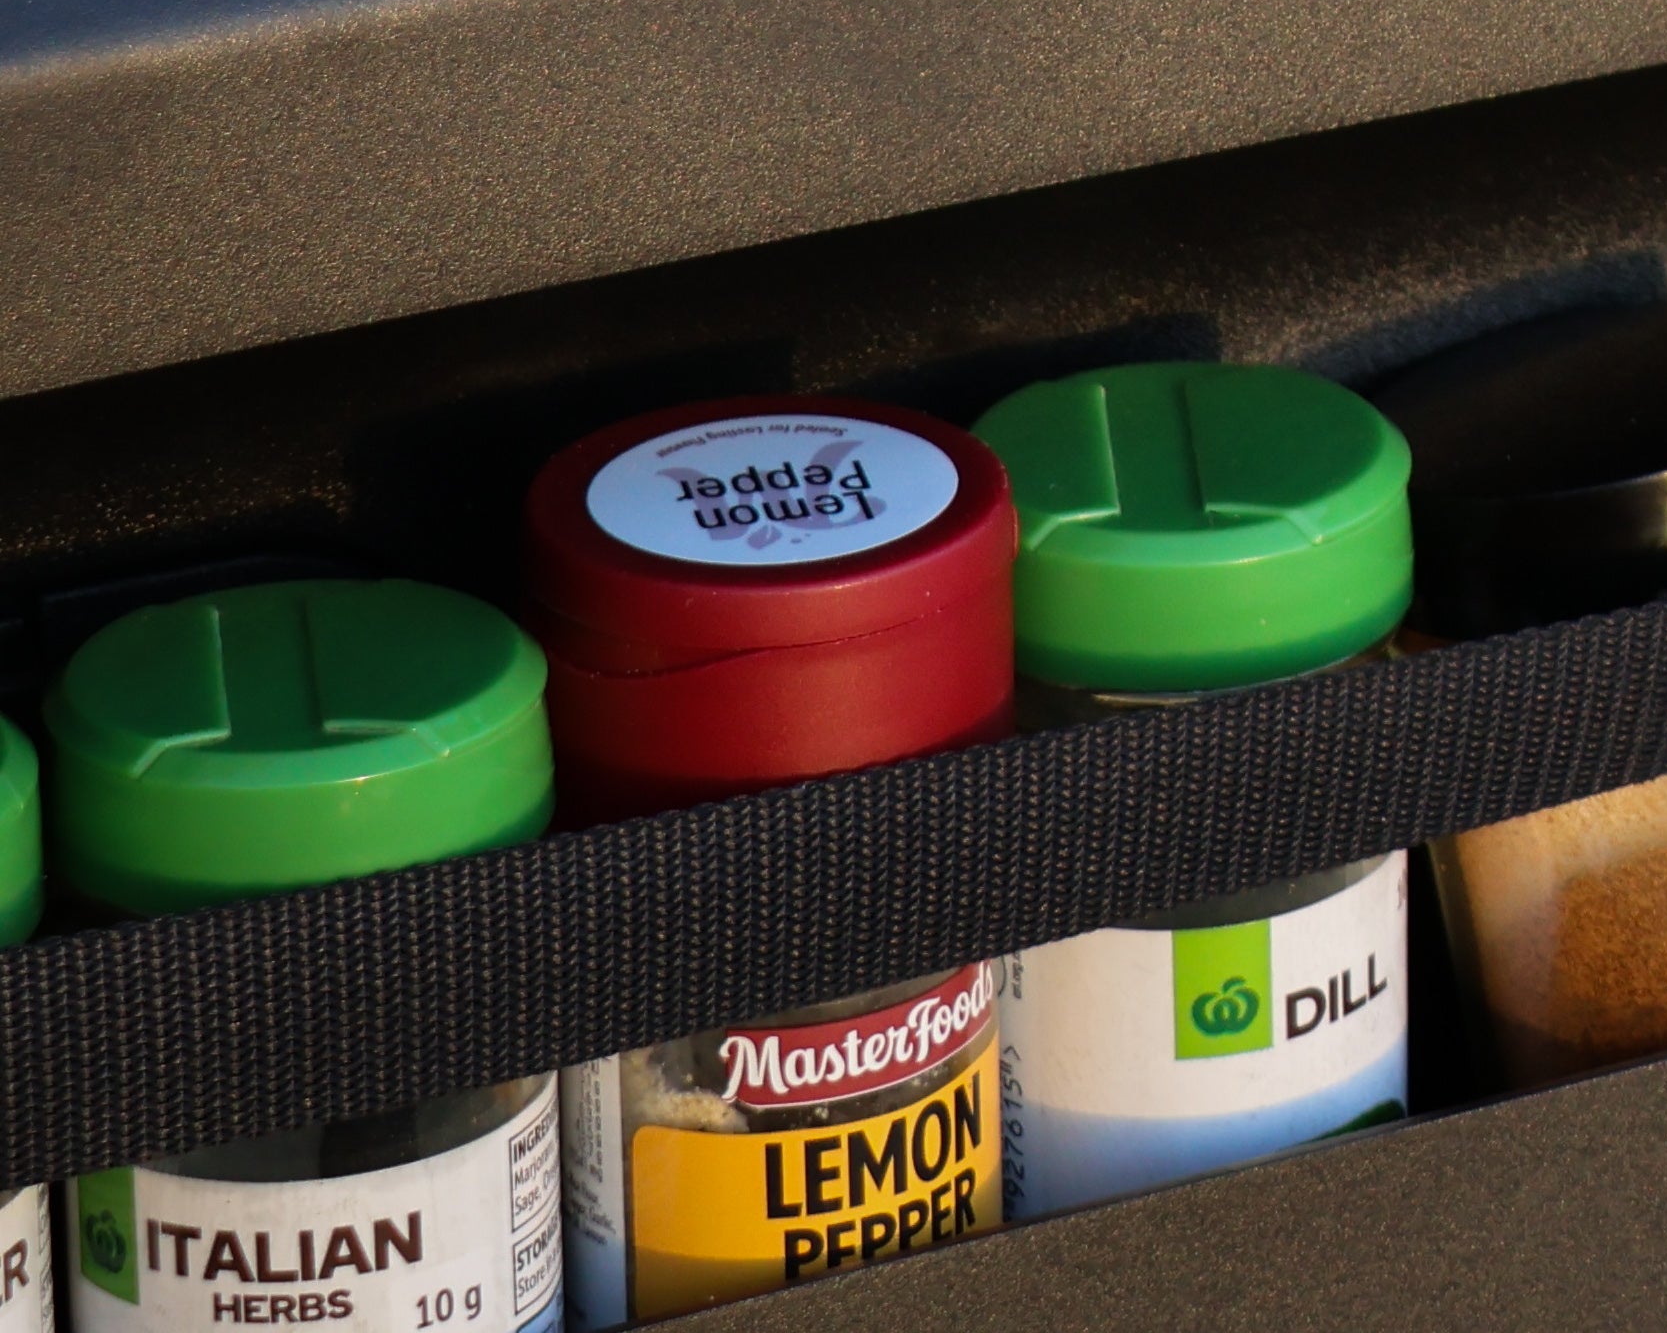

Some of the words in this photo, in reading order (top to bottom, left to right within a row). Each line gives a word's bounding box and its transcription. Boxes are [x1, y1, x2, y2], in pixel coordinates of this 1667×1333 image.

[675, 459, 873, 502] Pepper
[694, 490, 875, 530] Lemon
[718, 960, 995, 1102] MasterFoods
[1285, 950, 1388, 1041] DILL
[764, 1069, 982, 1220] LEMON
[145, 1209, 424, 1283] ITALIAN
[784, 1166, 977, 1281] PEPPER
[212, 1288, 355, 1324] HERBS
[415, 1287, 454, 1329] 10
[464, 1282, 482, 1321] g
